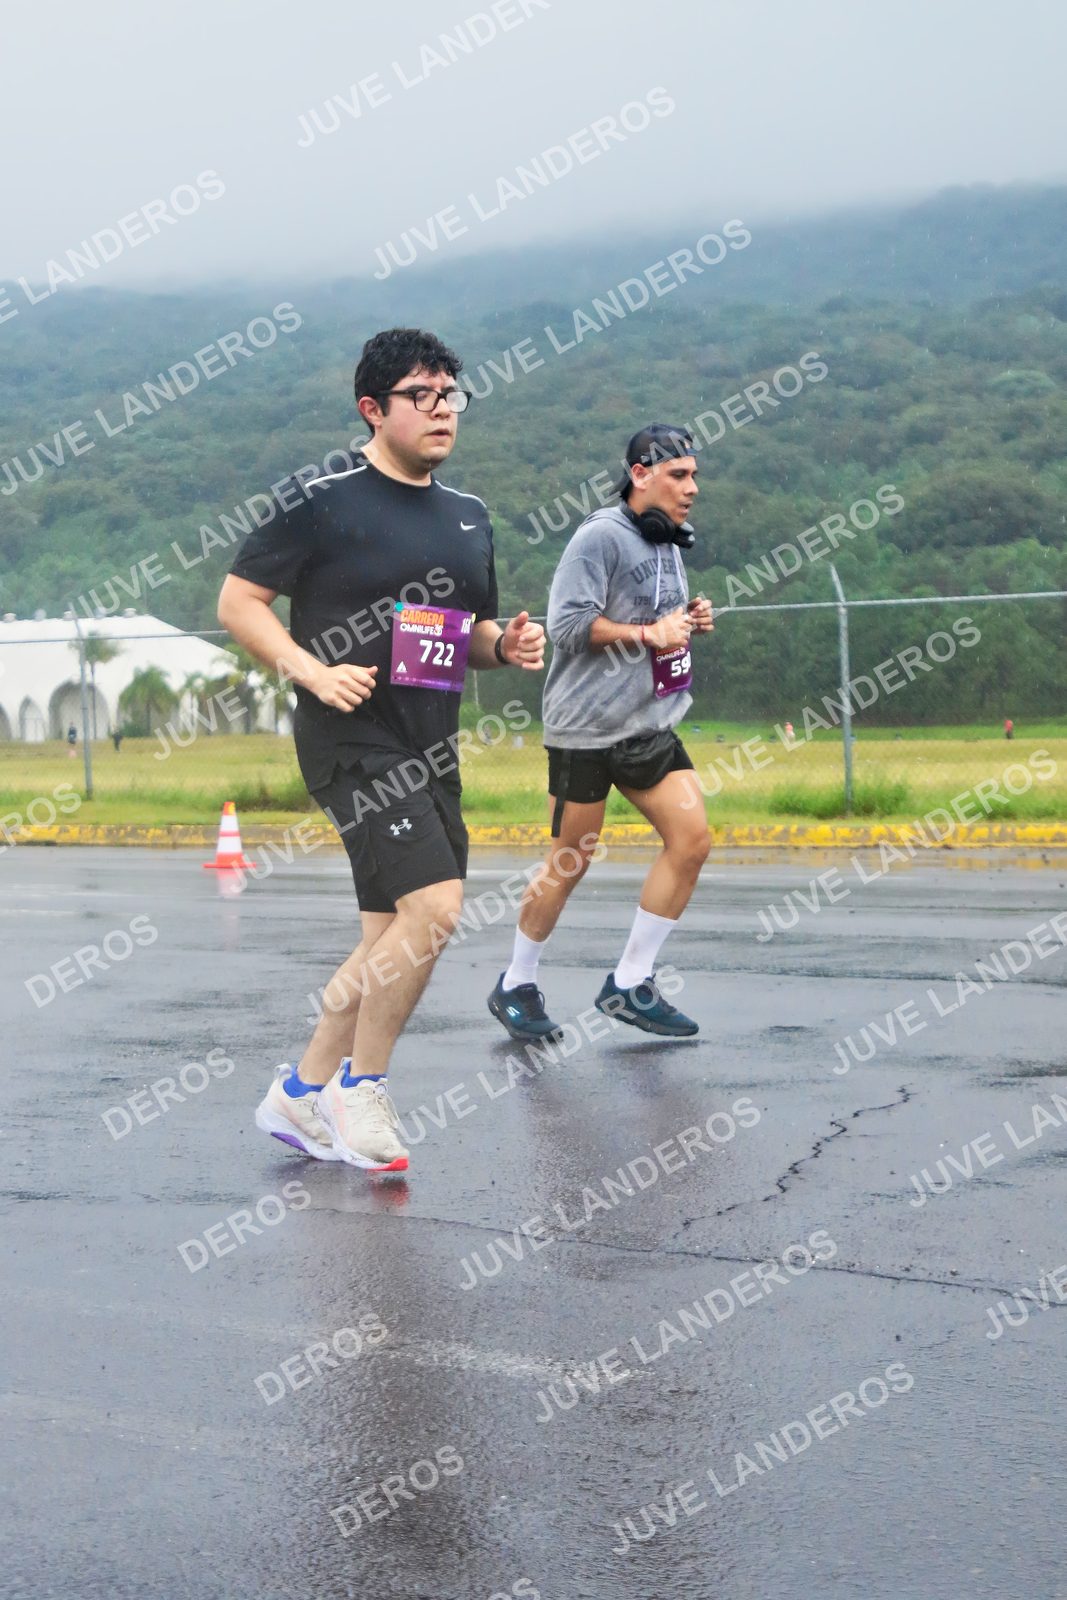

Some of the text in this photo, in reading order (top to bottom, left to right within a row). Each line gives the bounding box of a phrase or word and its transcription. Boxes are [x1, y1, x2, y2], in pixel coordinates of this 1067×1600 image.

[400, 609, 445, 626] CARRERA
[419, 639, 455, 667] 722
[671, 651, 691, 677] 59
